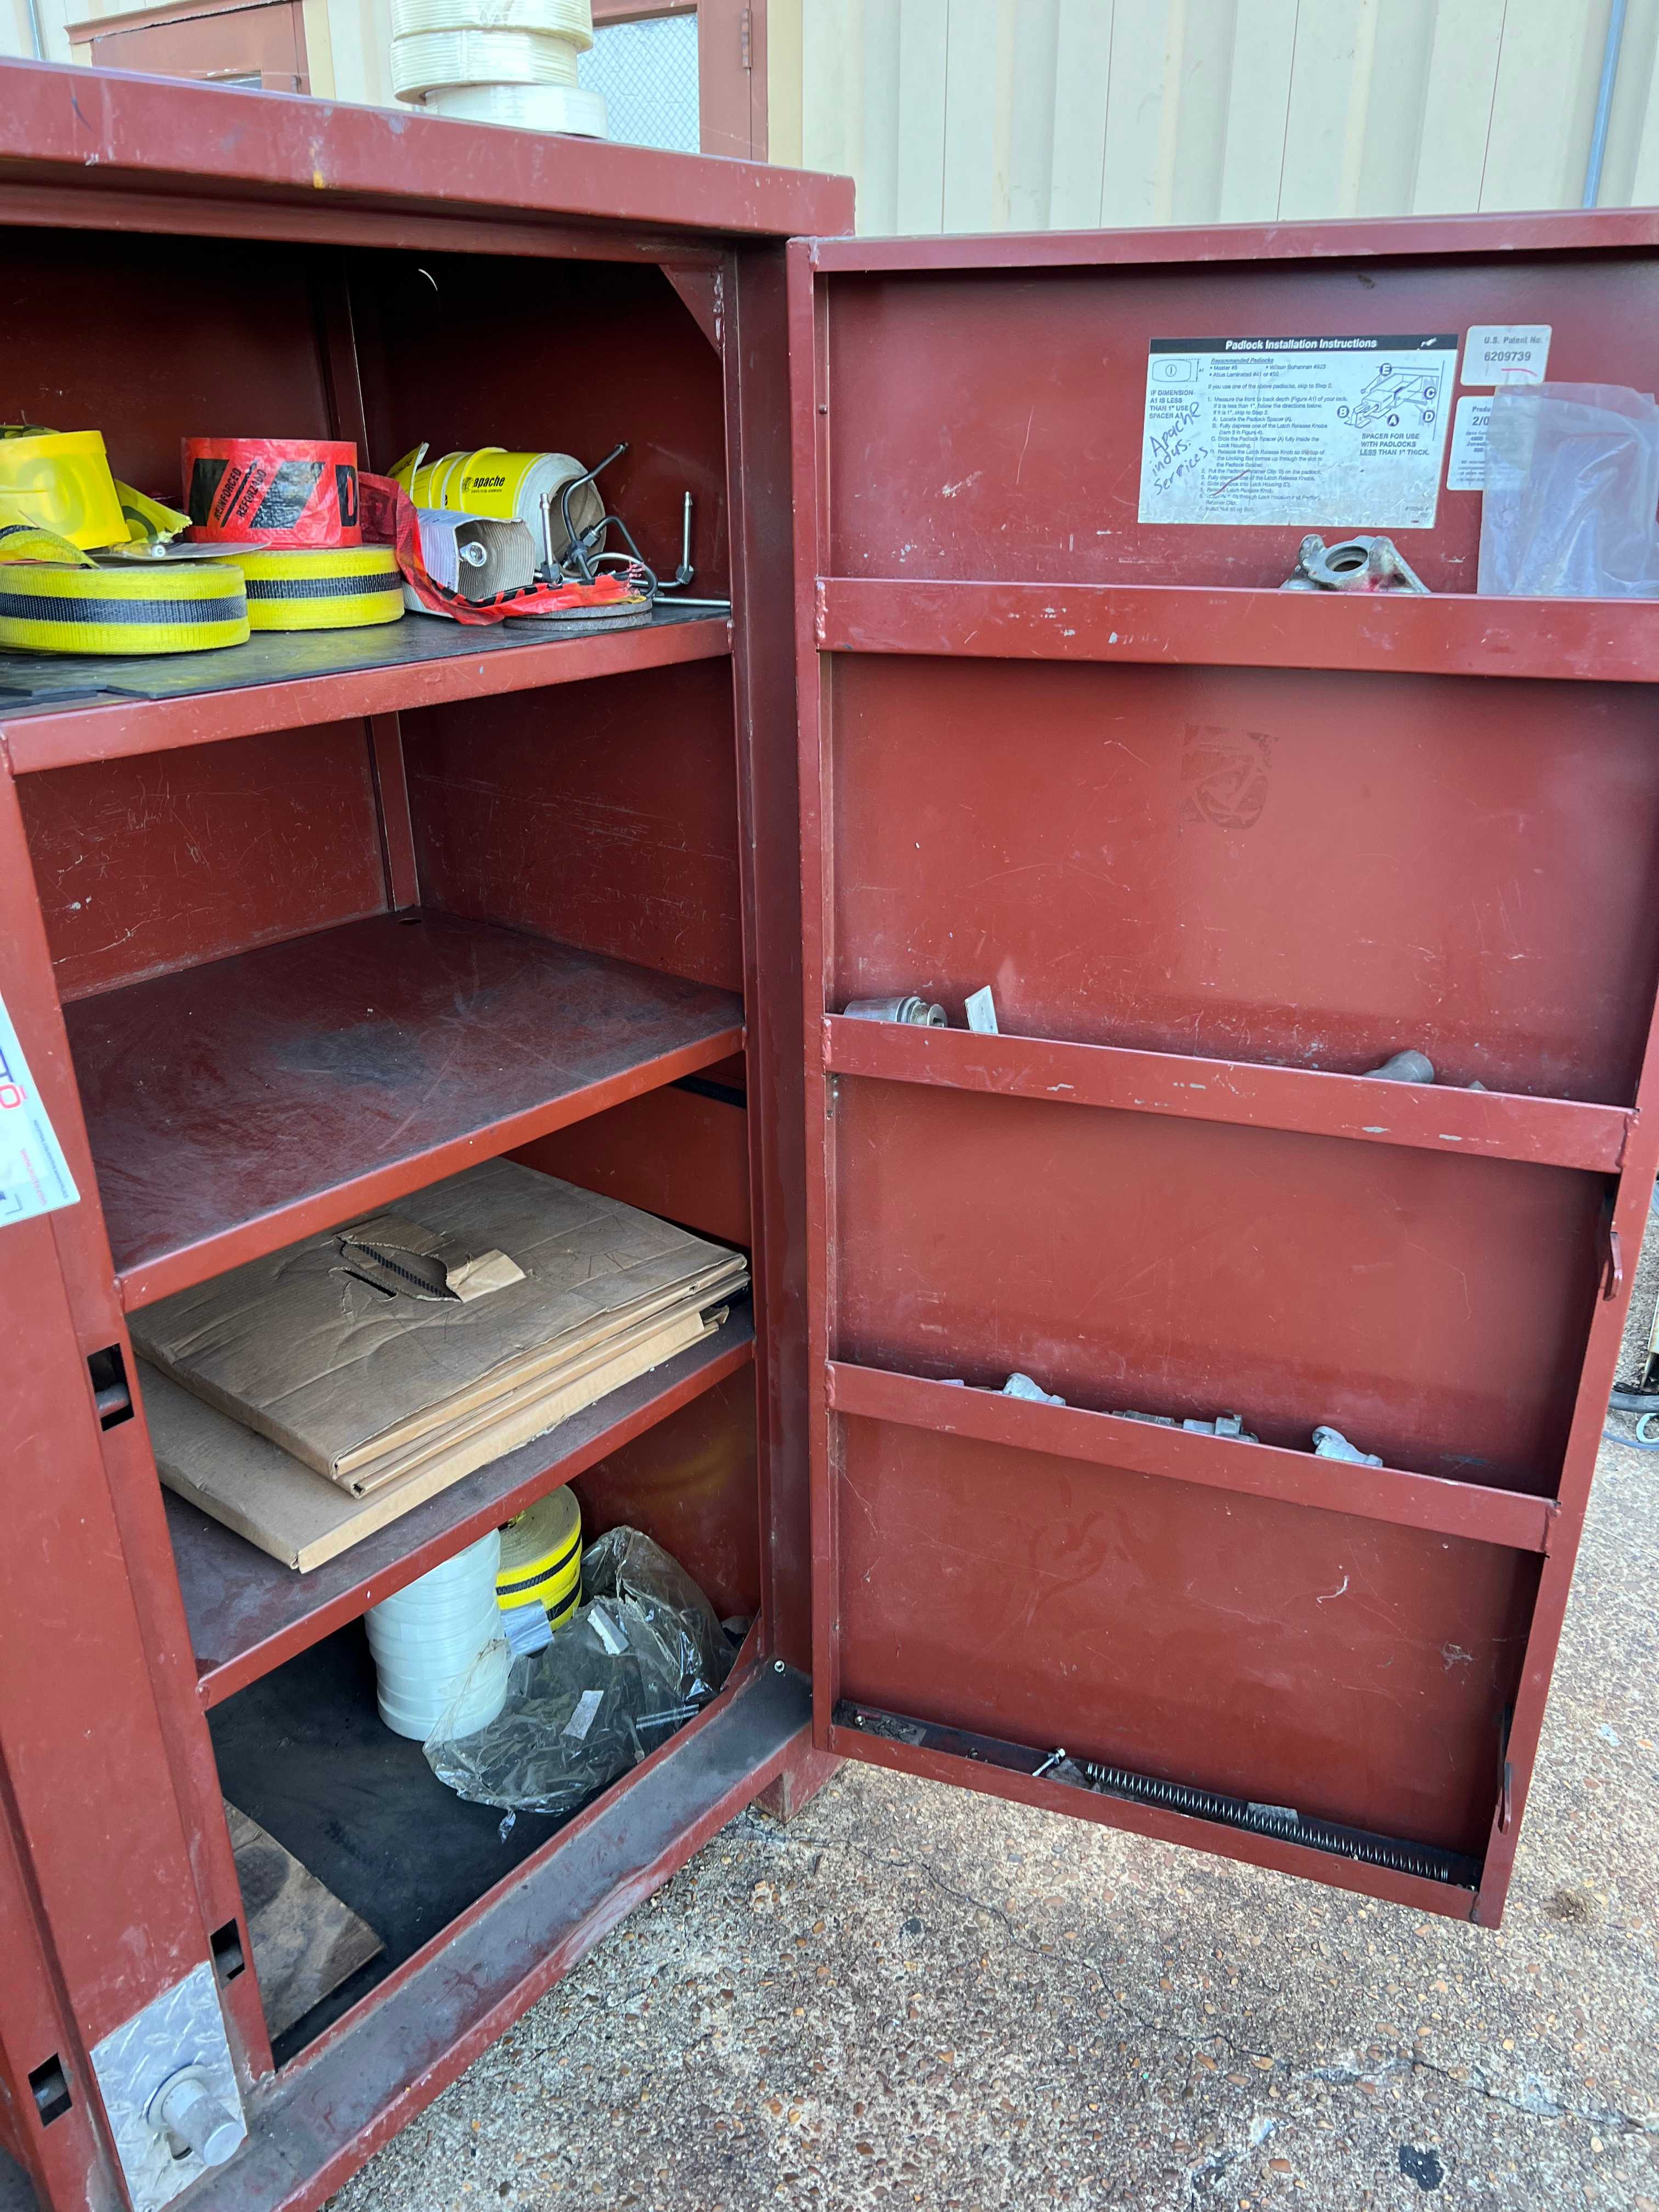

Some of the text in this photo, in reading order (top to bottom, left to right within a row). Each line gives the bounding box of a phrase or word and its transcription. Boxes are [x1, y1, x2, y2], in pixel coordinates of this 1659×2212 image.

[1225, 338, 1377, 351] Padlock Installation Instructions
[1484, 351, 1531, 362] 6209739
[1150, 402, 1201, 458] Apache
[213, 467, 242, 521] REINFORCED
[236, 469, 267, 518] REFORZADO
[473, 476, 505, 488] apache
[1154, 447, 1208, 496] Services
